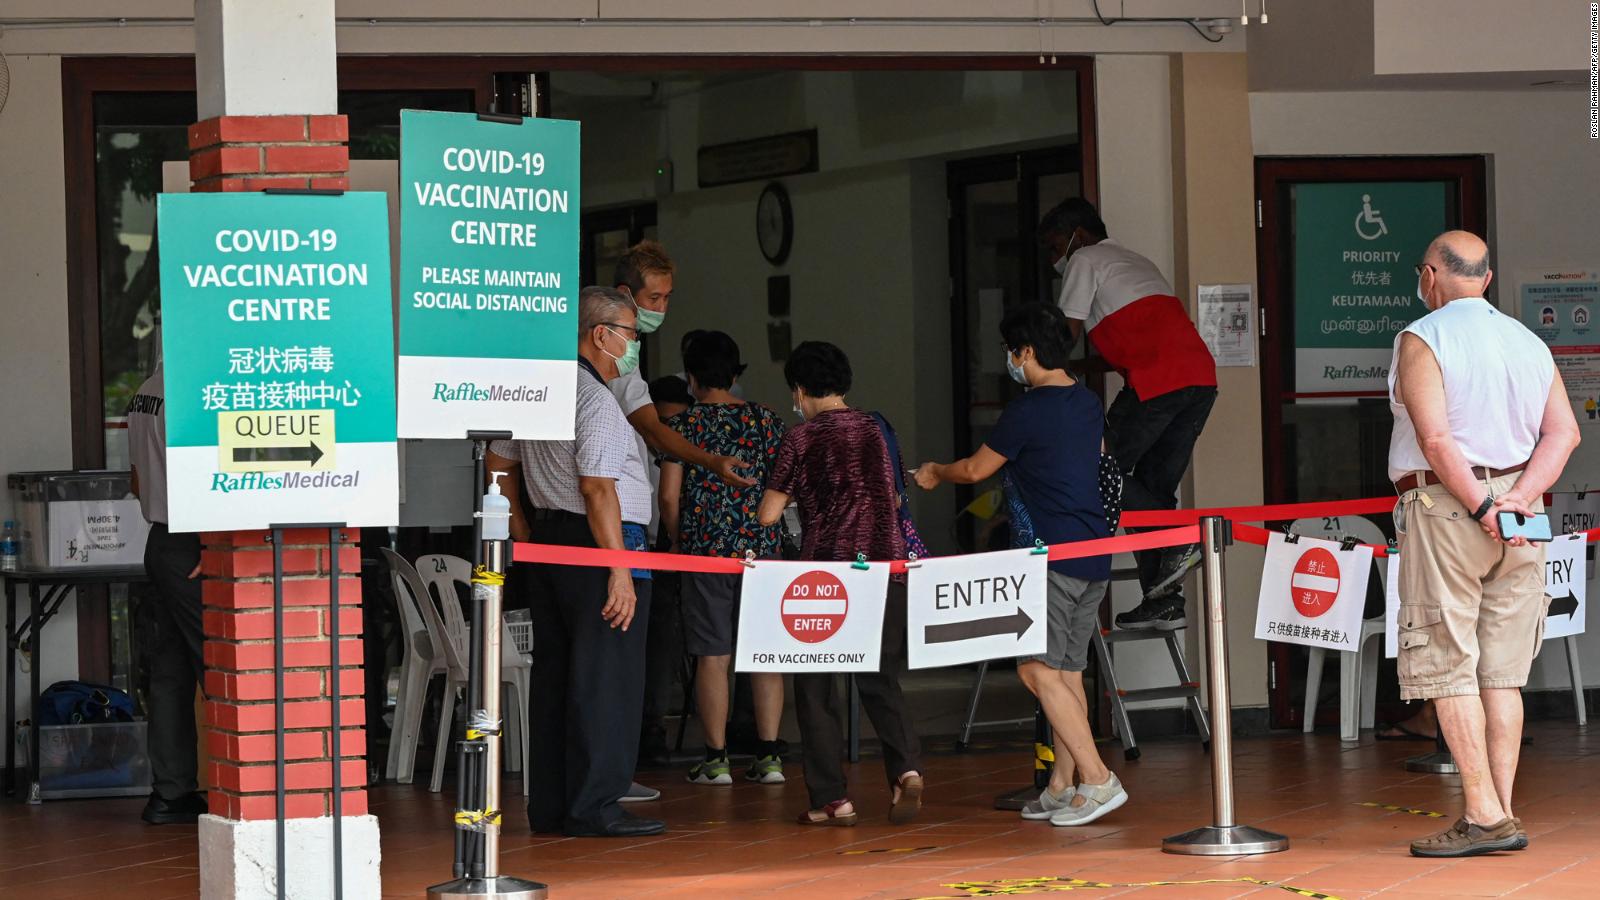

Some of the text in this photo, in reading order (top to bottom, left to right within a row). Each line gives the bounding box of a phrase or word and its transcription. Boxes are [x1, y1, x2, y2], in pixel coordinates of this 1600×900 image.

[443, 147, 545, 176] COVID-19
[414, 182, 568, 213] VACCINATION
[215, 229, 337, 252] COVID-19
[451, 220, 537, 247] CENTRE
[1343, 251, 1401, 263] PRIORITY
[183, 263, 368, 288] VACCINATION
[422, 267, 561, 288] PLEASE MAINTAIN
[1351, 271, 1392, 286] 优先者
[228, 298, 331, 322] CENTRE
[413, 291, 567, 313] SOCIAL DISTANCING
[1332, 295, 1411, 307] KEUTAMAAN
[228, 345, 334, 374] 冠状病毒
[202, 380, 362, 410] 疫苗接种中心
[432, 382, 548, 403] RafflesMedical
[235, 415, 321, 439] QUEUE
[210, 470, 360, 493] RafflesMedical
[1322, 517, 1341, 530] 21
[432, 557, 448, 573] 24
[1307, 559, 1326, 575] 禁止
[1545, 558, 1574, 586] TRY
[792, 584, 839, 597] DO NOT
[934, 573, 1027, 611] ENTRY
[1302, 591, 1321, 606] 进入
[794, 618, 832, 631] ENTER
[1267, 621, 1350, 644] 只供疫苗接种者进入
[753, 653, 866, 664] FOR VACCINEES ONLY
